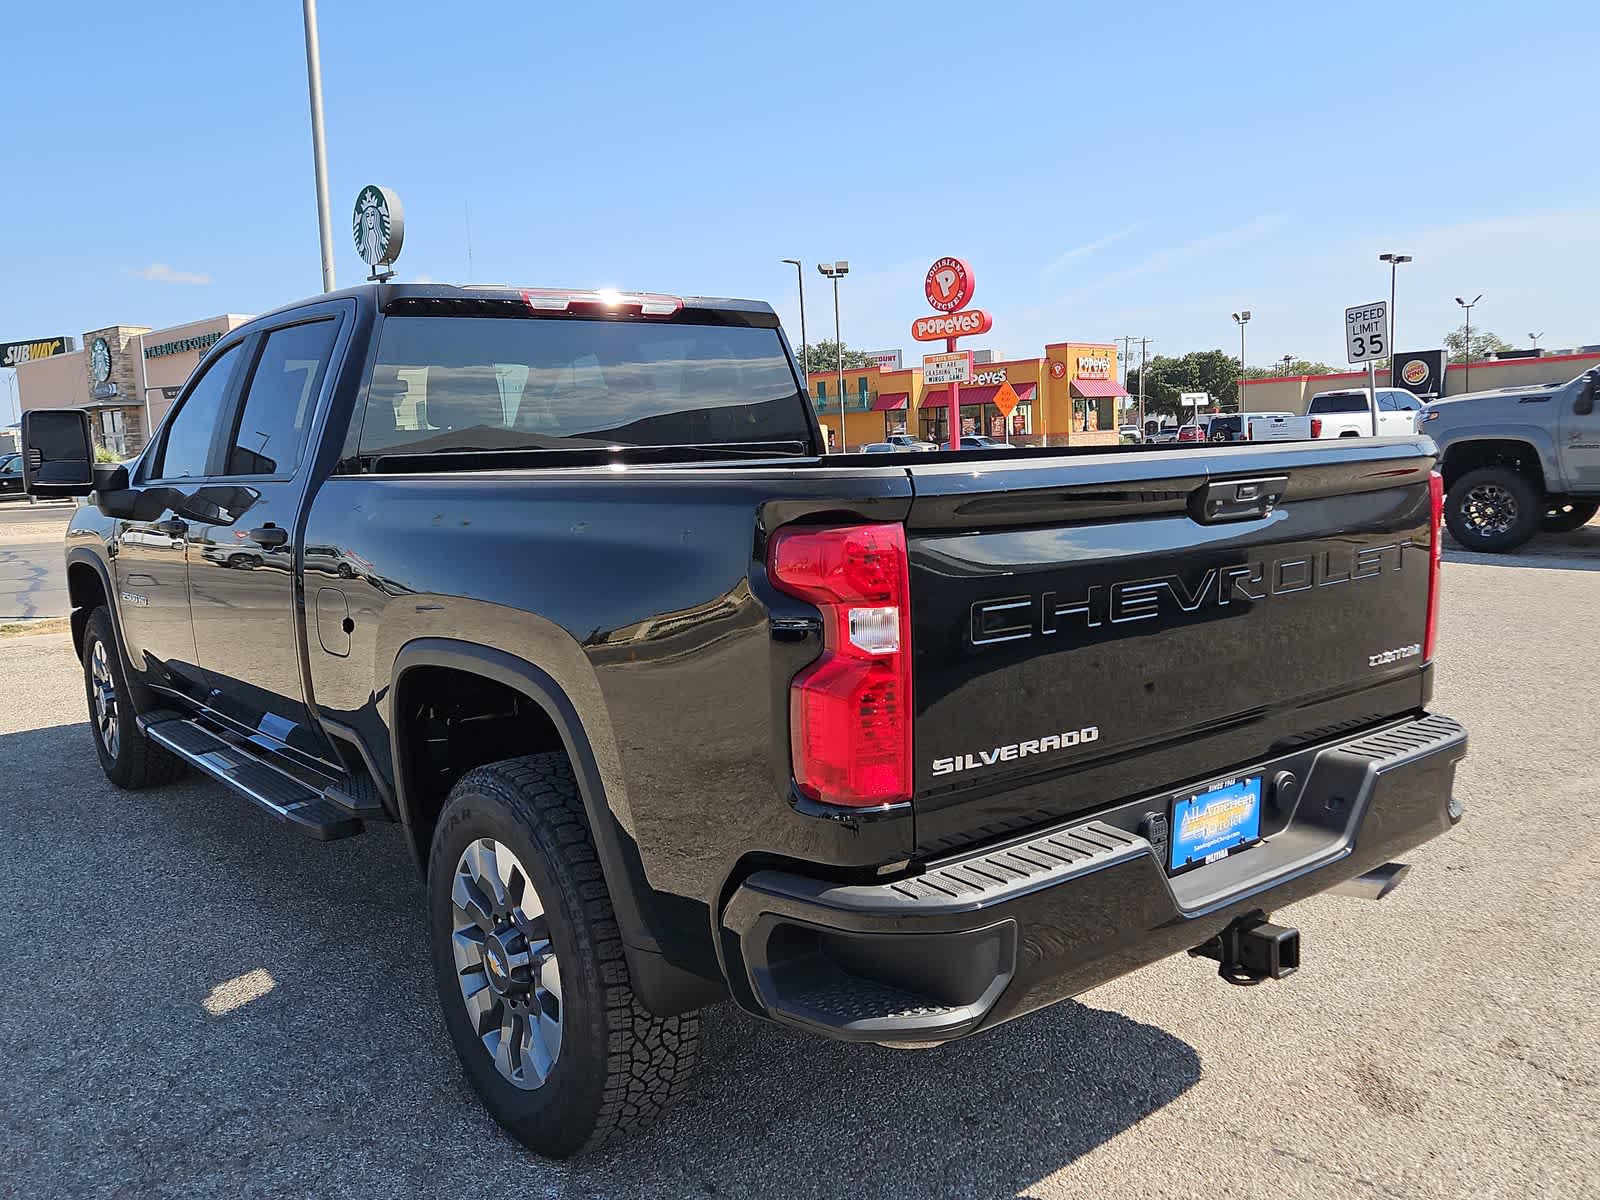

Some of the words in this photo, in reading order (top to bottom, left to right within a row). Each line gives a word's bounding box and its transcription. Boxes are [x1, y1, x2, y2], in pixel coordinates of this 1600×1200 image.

[927, 259, 965, 284] LOUISIANA
[935, 269, 956, 298] P
[928, 290, 965, 310] KITCHEN
[1347, 307, 1385, 324] SPEED
[1352, 320, 1381, 336] LIMIT
[3, 340, 60, 364] SUBWAY
[1352, 333, 1384, 357] 35
[970, 538, 1414, 646] CHEVROLET
[932, 726, 1099, 776] SILVERADO
